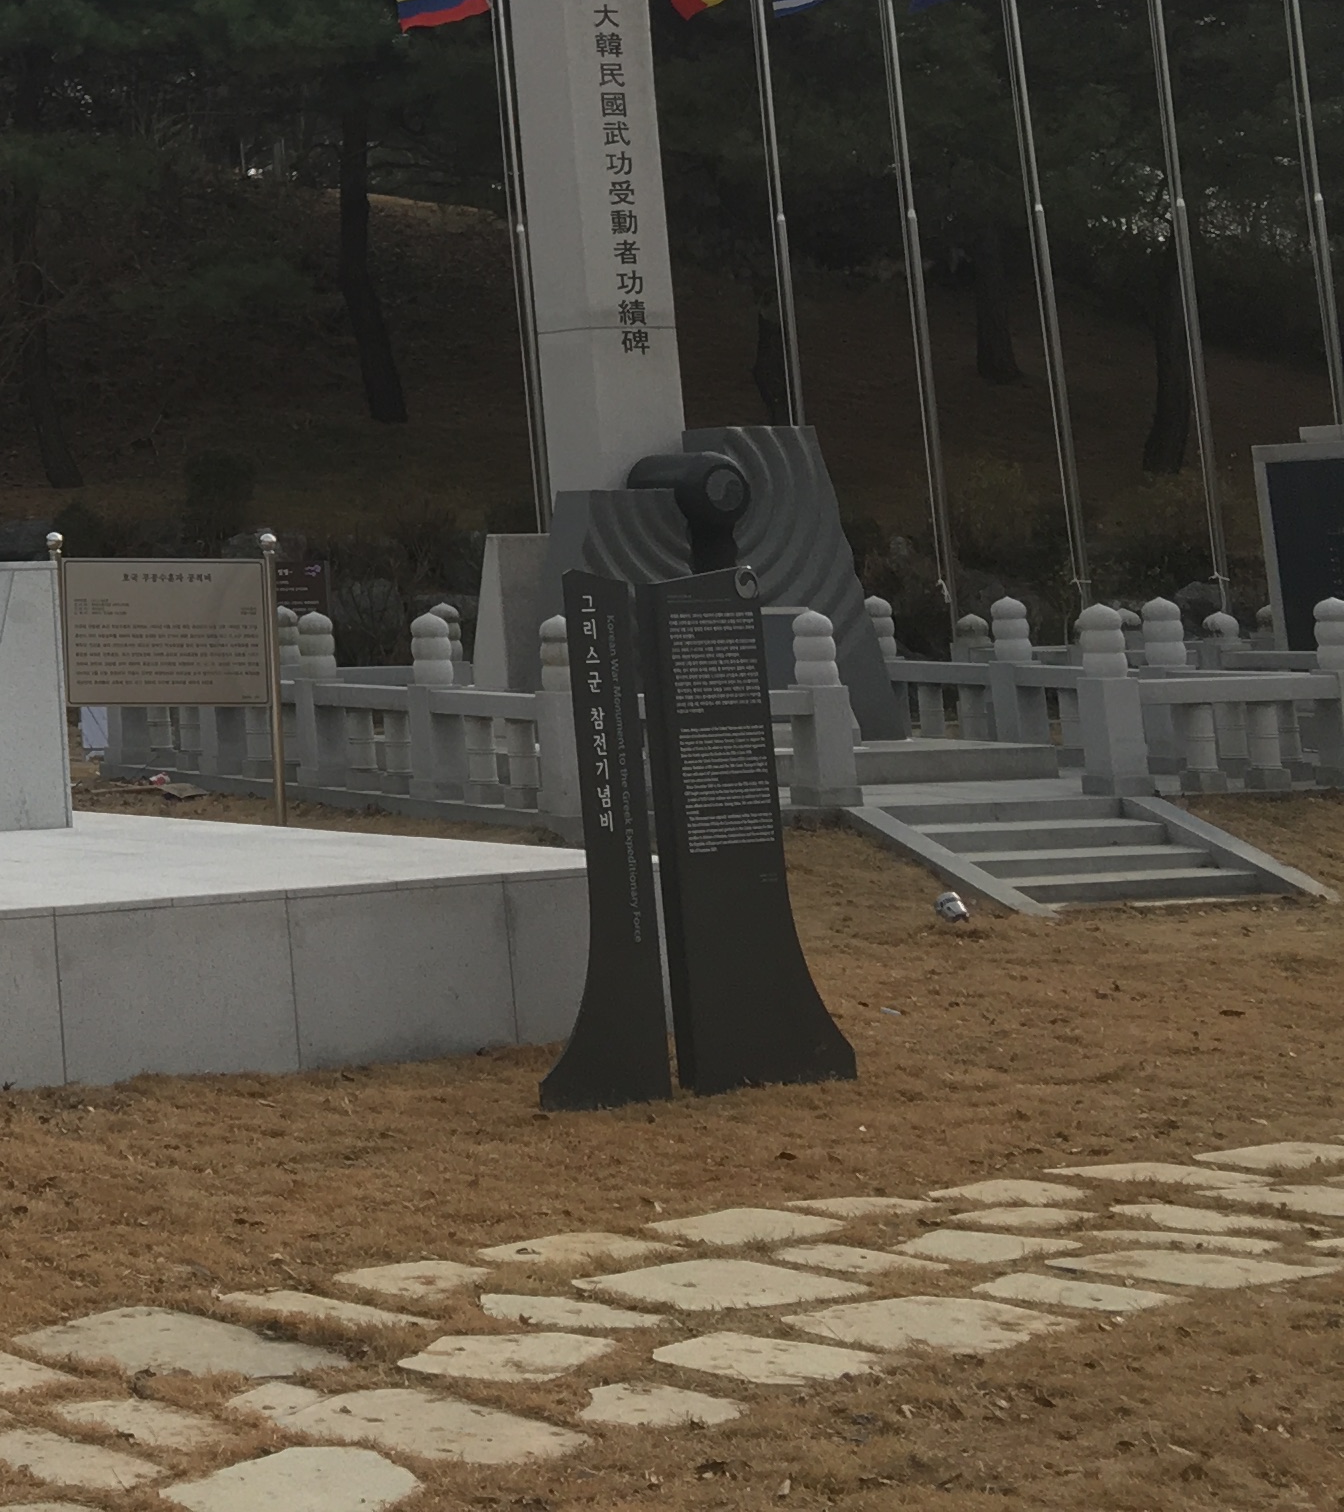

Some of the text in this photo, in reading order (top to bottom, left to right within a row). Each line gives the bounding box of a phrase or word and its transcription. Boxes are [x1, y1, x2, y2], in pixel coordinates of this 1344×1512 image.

[581, 595, 614, 832] 그리스군 참전기념비
[606, 614, 642, 943] Korean War Monument to the Greek Expeditionary Force
